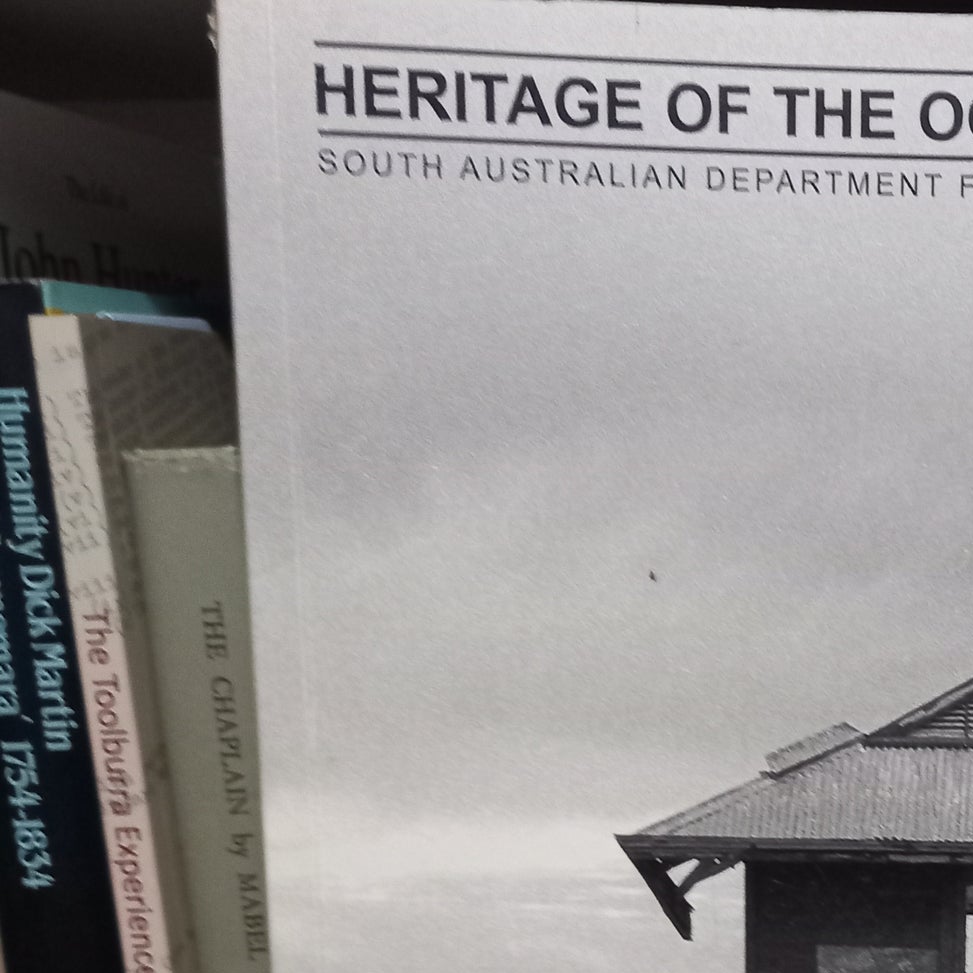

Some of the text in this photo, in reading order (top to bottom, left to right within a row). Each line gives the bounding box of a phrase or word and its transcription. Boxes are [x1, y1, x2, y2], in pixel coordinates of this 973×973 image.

[314, 64, 643, 131] HERITAGE
[666, 82, 751, 134] OF
[773, 86, 895, 140] THE
[318, 148, 443, 180] SOUTH
[459, 155, 686, 191] AUSTRALIAN
[706, 166, 943, 198] DEPARTMENT
[0, 387, 79, 751] Humanity Dick Martin
[83, 608, 113, 666] The
[202, 600, 230, 660] THE
[93, 673, 131, 817] Toolburra
[212, 676, 250, 816] CHAPLAIN
[1, 741, 56, 890] 1754-1834
[227, 833, 253, 857] by
[238, 873, 269, 961] MABEL
